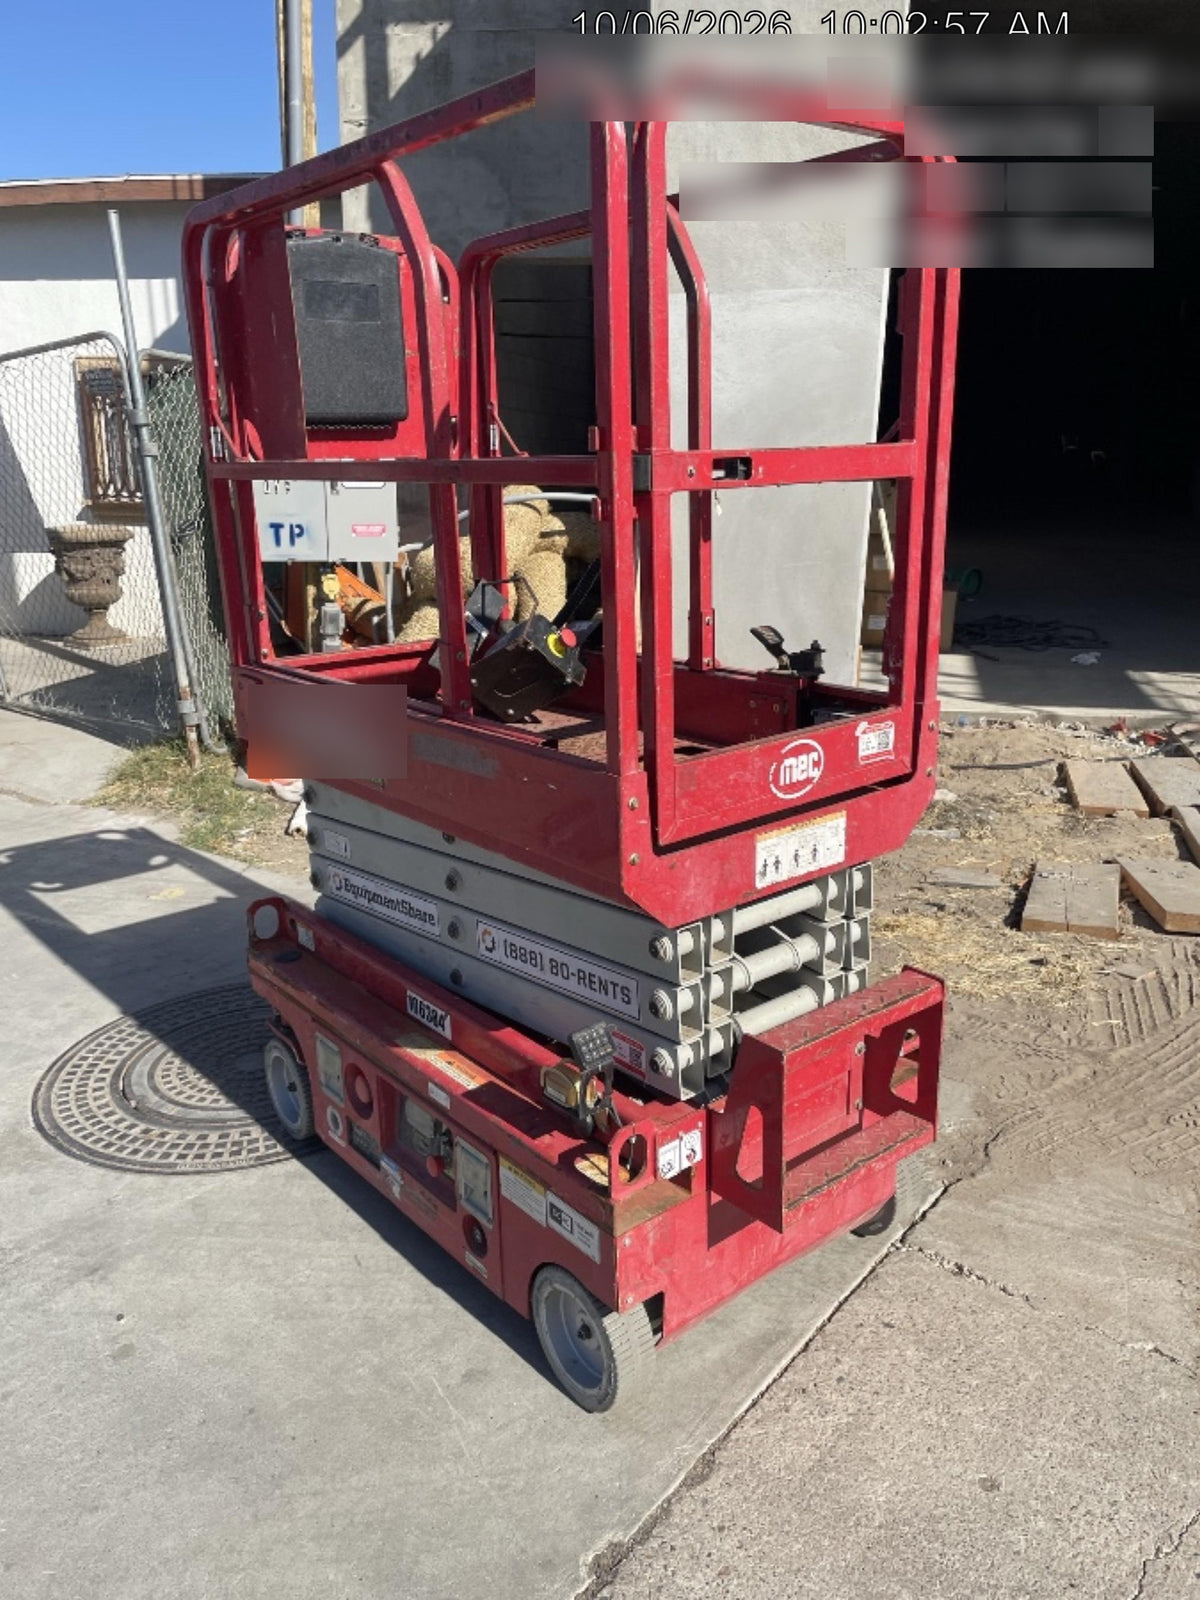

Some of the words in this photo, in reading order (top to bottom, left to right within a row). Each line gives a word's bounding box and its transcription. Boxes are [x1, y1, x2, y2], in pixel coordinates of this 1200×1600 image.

[268, 522, 305, 547] TP
[343, 878, 437, 926] EquipmentShare
[503, 938, 545, 971] (888)
[549, 957, 632, 1005] 80-RENTS
